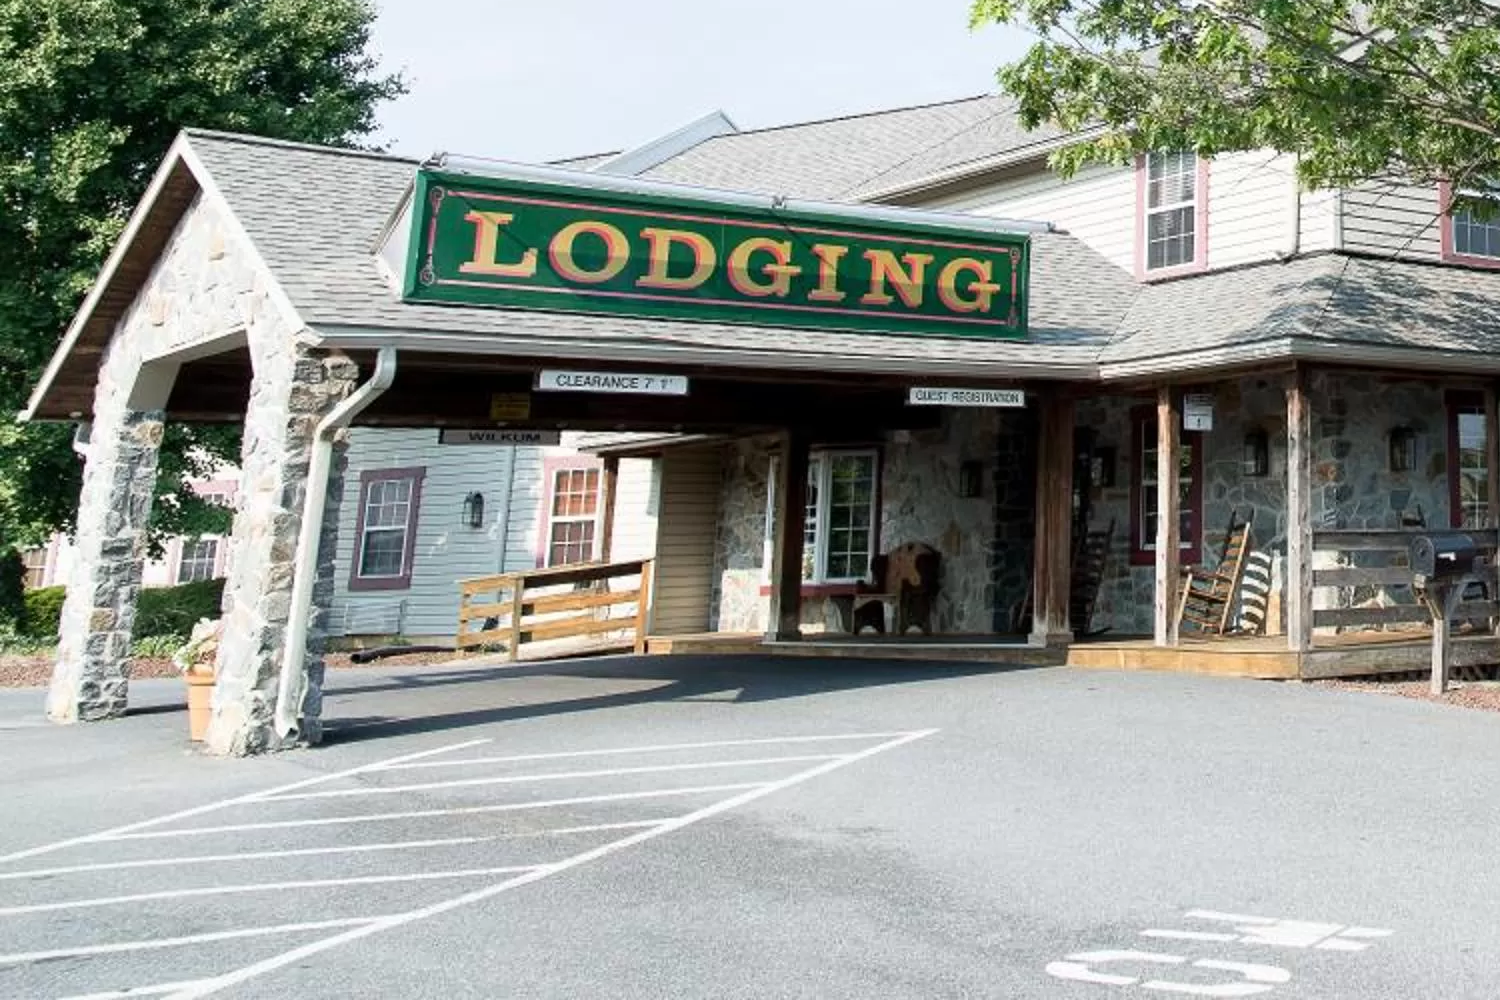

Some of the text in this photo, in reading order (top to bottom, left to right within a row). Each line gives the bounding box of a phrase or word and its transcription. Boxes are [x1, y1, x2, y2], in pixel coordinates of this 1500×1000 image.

[459, 210, 1000, 313] LODGING
[555, 374, 639, 389] CLEARANCE
[915, 390, 1020, 403] GUEST REGISTRATION
